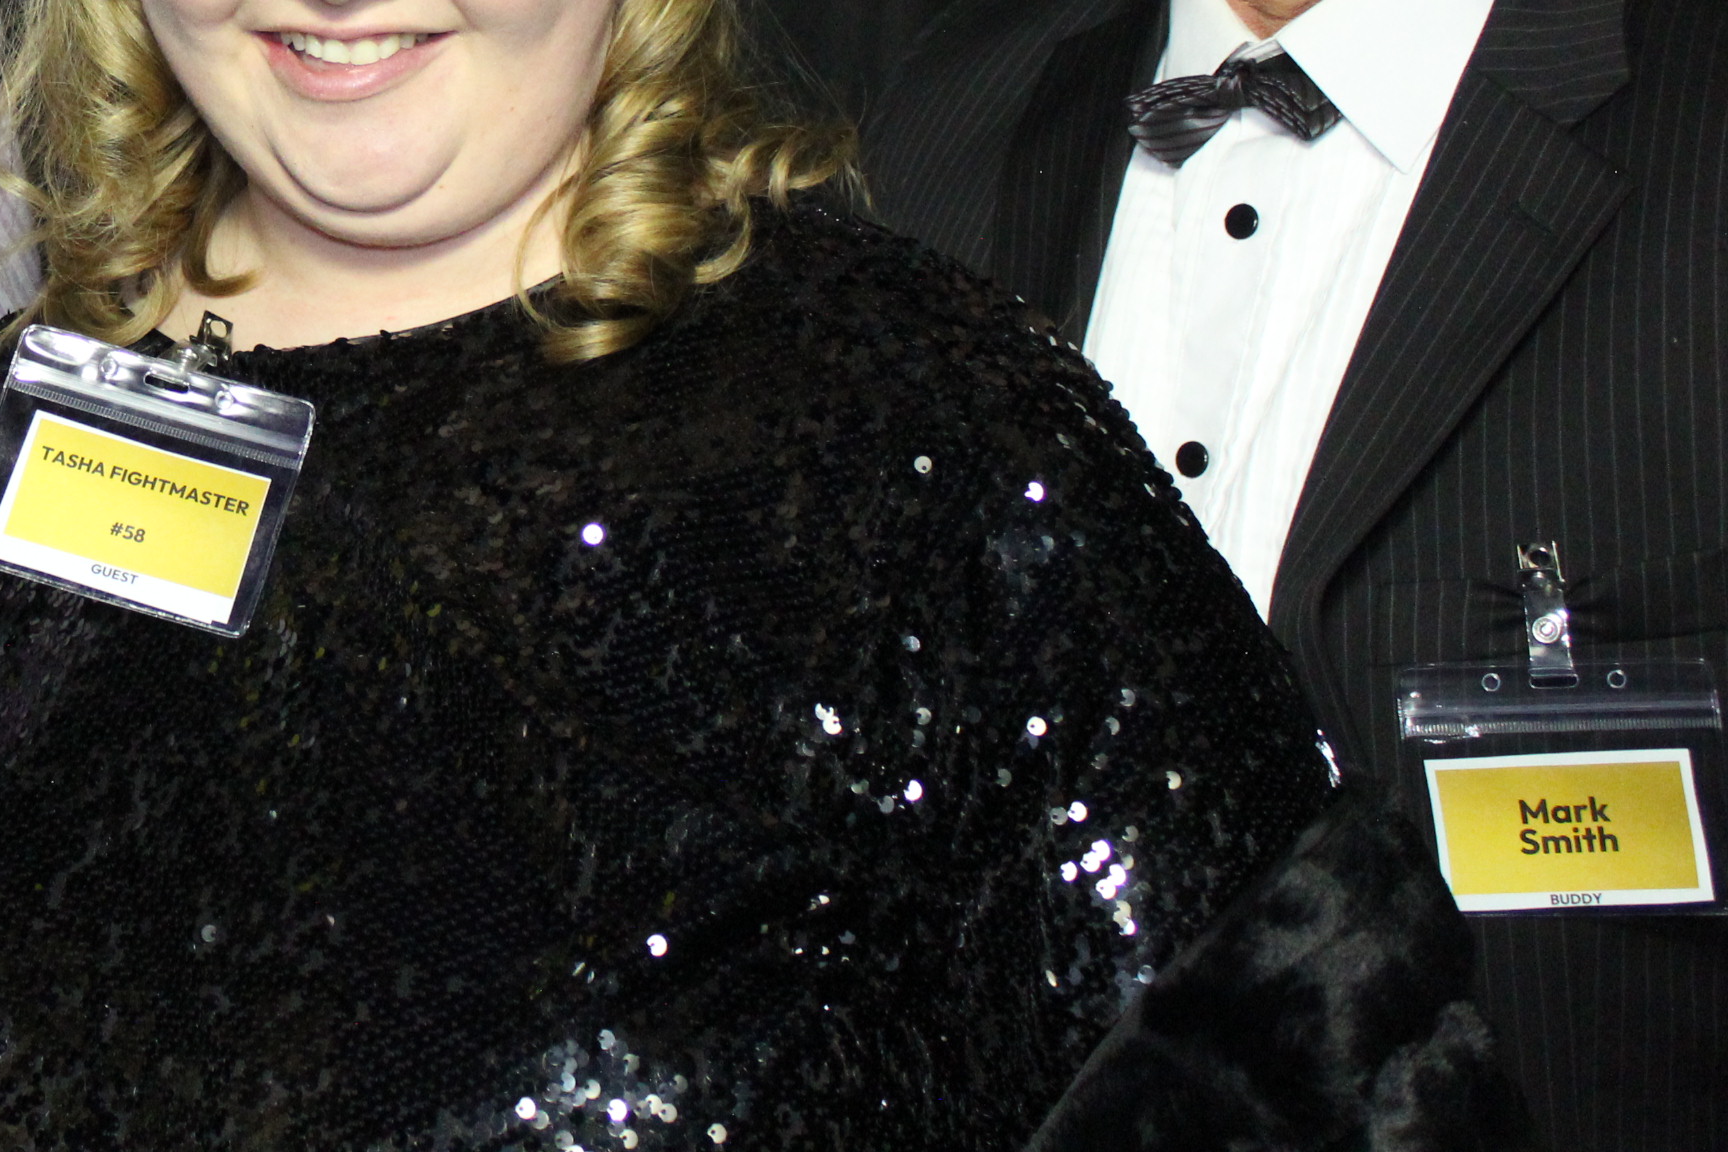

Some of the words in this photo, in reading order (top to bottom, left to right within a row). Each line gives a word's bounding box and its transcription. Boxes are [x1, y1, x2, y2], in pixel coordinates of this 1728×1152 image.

[41, 445, 105, 477] TASHA
[109, 466, 251, 517] FIGHTMASTER
[110, 521, 147, 544] #58
[90, 563, 140, 586] GUEST
[1518, 796, 1611, 825] Mark
[1519, 826, 1620, 856] Smith
[1550, 892, 1603, 906] BUDDY
